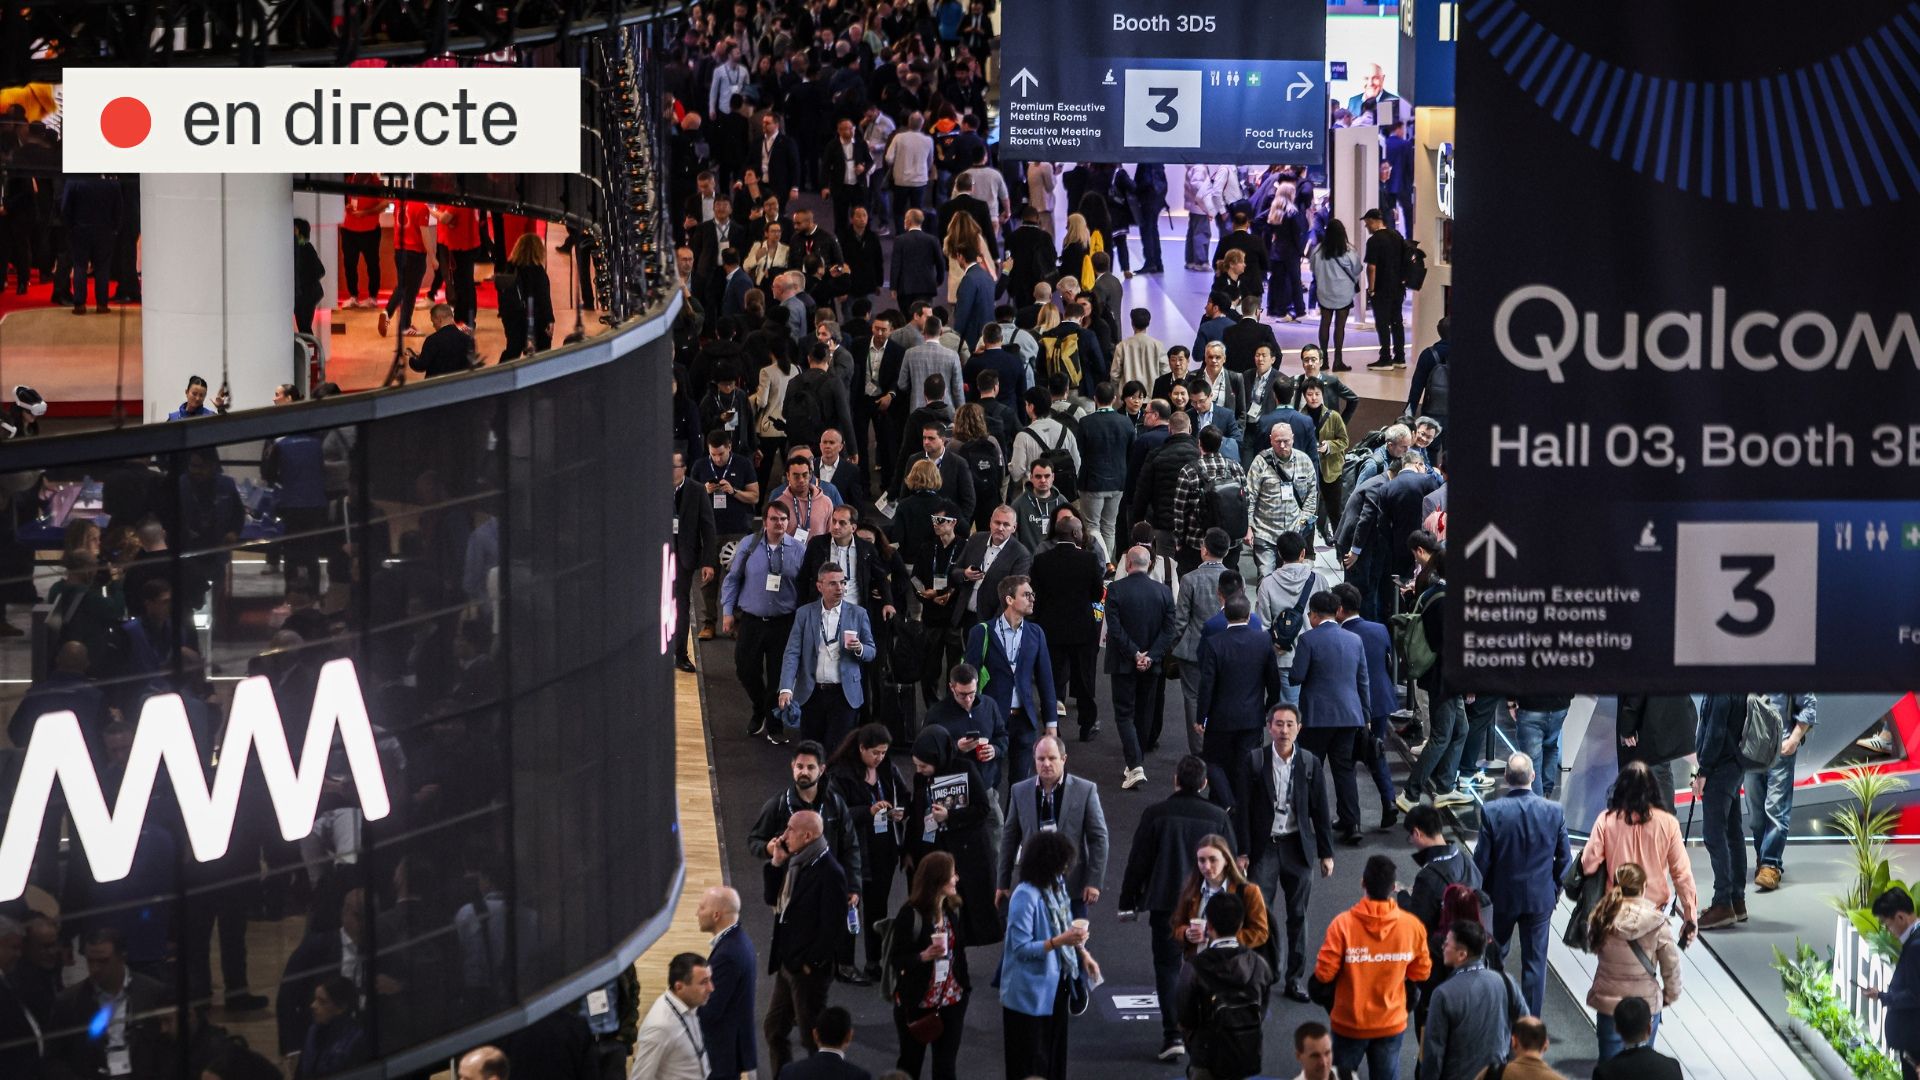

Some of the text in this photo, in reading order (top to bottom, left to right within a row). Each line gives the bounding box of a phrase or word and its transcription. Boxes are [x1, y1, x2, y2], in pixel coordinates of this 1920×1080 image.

[1112, 13, 1216, 33] Booth 3D5
[1010, 101, 1106, 112] Premium Executive
[1145, 87, 1179, 133] 3
[1010, 112, 1088, 123] Meeting Rooms
[1010, 126, 1101, 138] Executive Meeting
[1245, 128, 1314, 139] Food Trucks
[1009, 136, 1081, 147] Rooms (West)
[1257, 140, 1314, 151] Courtyard
[1490, 423, 1590, 467] Hall
[1605, 424, 1686, 474] 03,
[1700, 423, 1854, 467] Booth
[1464, 586, 1641, 603] Premium Executive
[1715, 554, 1776, 638] 3
[1464, 605, 1607, 624] Meeting Rooms
[1463, 631, 1632, 650] Executive Meeting
[1463, 650, 1595, 668] Rooms (West)
[1345, 952, 1413, 963] EXPLORERS
